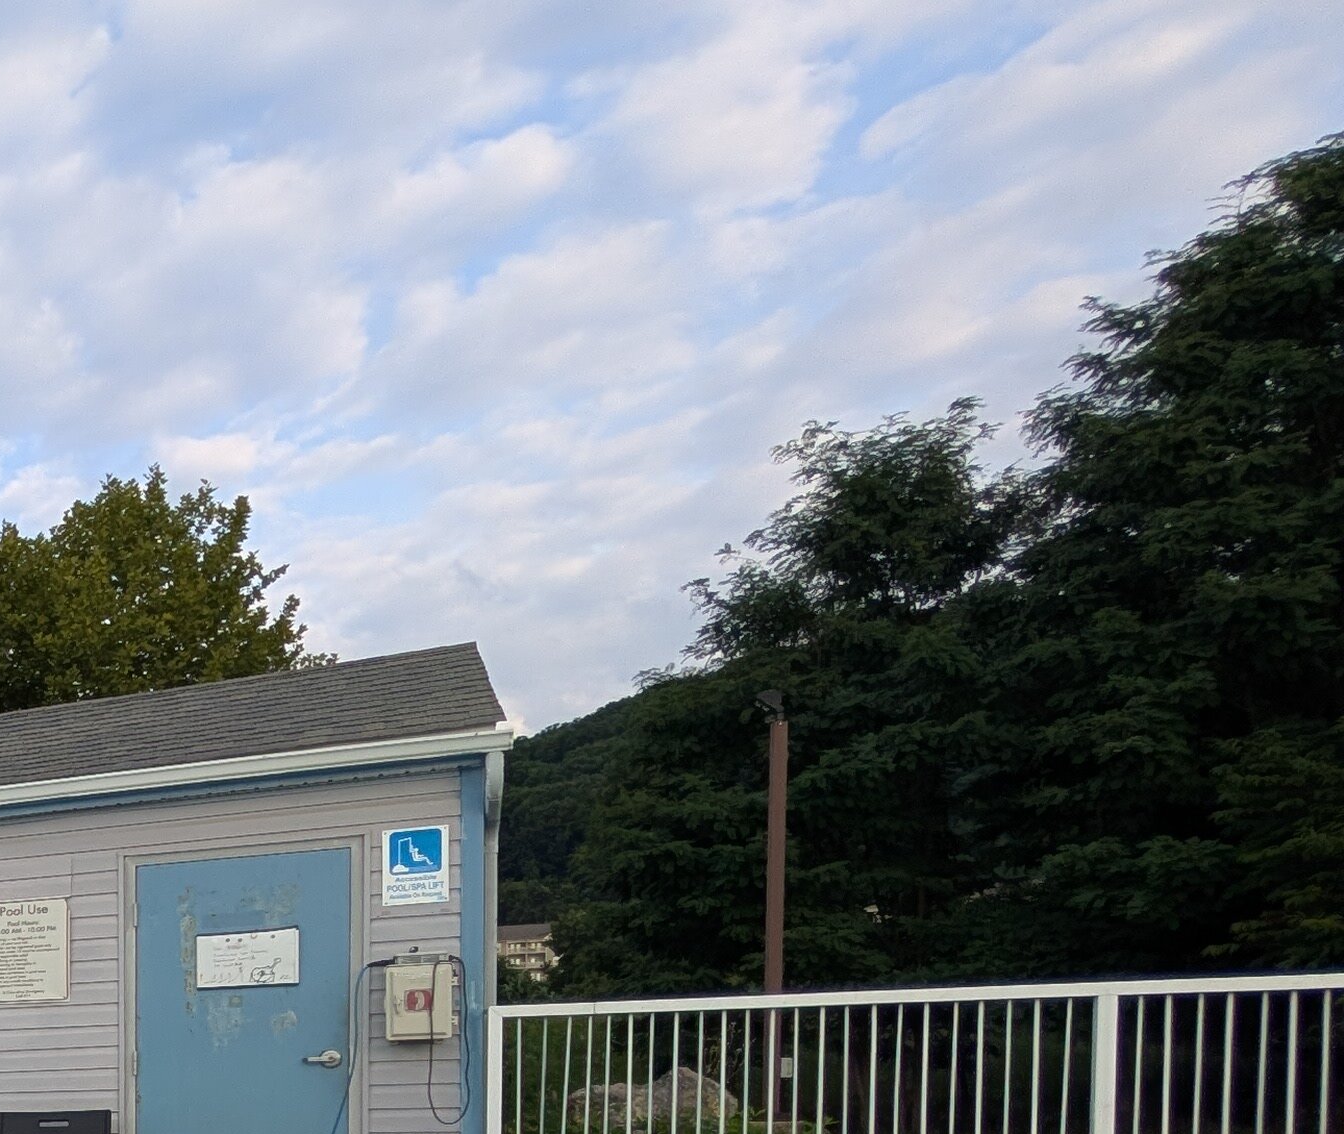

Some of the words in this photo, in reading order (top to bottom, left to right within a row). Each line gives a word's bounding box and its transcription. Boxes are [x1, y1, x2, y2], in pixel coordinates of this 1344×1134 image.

[428, 881, 444, 889] LIFT
[0, 904, 24, 917] Pool
[27, 904, 49, 915] Use
